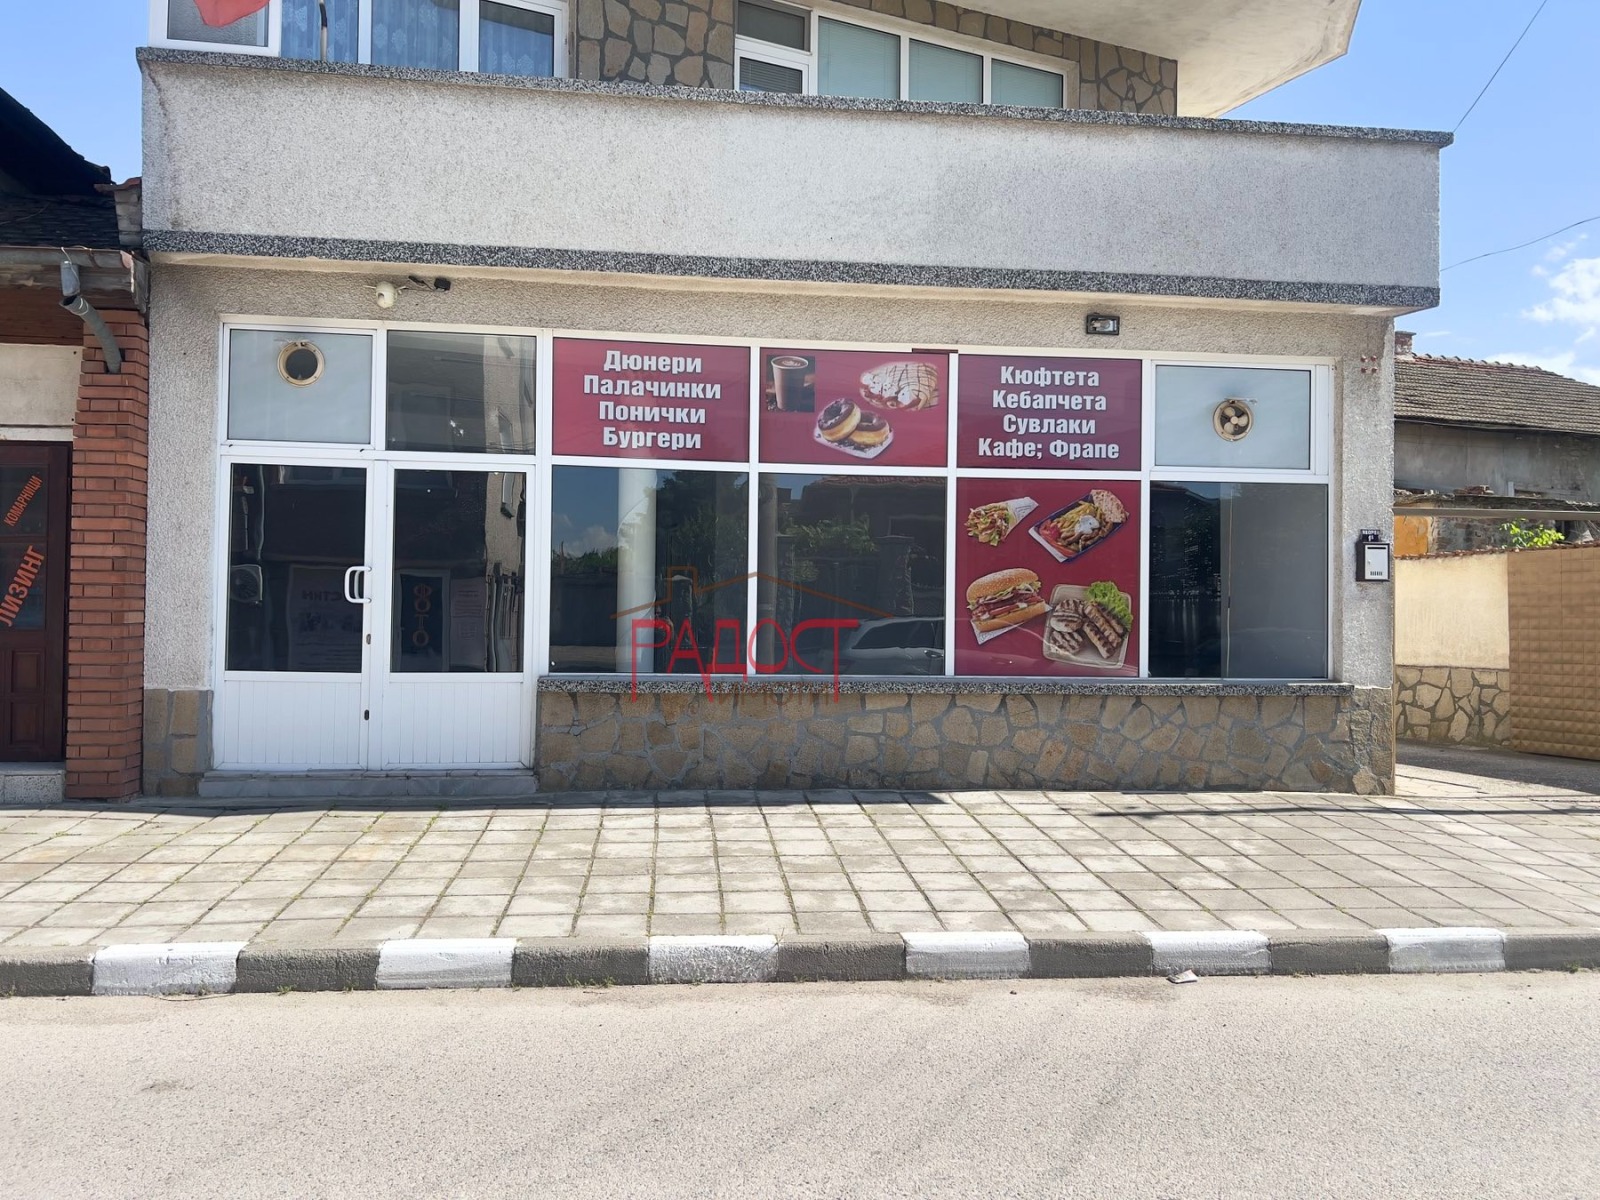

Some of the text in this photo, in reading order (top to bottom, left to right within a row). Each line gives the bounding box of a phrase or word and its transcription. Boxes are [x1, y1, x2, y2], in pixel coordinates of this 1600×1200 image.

[603, 349, 702, 374] Дюнери
[583, 375, 721, 399] Палачинки
[1000, 366, 1100, 387] Кюфтета
[992, 390, 1107, 410] Кебапчета
[599, 401, 706, 424] Понички
[1003, 414, 1096, 435] Сувлаки
[603, 427, 701, 450] Бургери
[978, 438, 1120, 460] Кафе; Фрапе
[4, 475, 43, 527] КОМАРНИЦИ
[0, 545, 45, 627] ЛИЗИНГ
